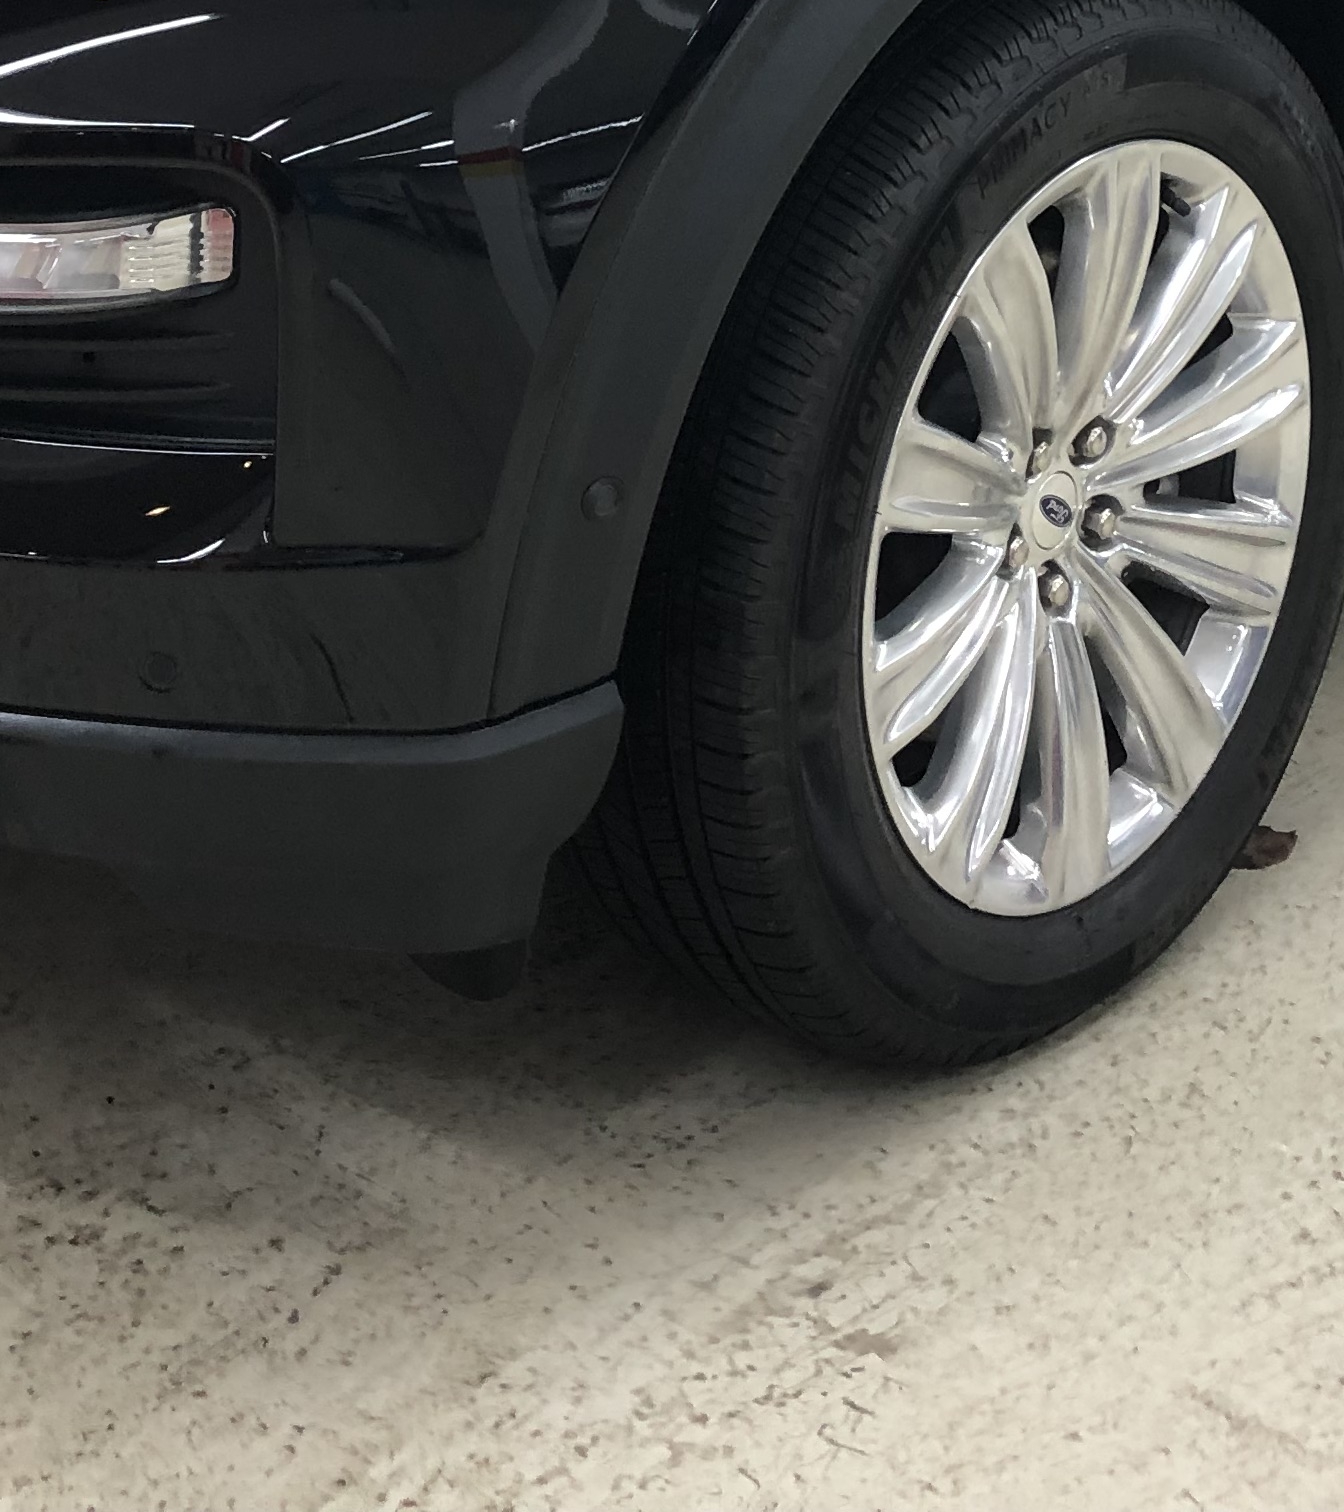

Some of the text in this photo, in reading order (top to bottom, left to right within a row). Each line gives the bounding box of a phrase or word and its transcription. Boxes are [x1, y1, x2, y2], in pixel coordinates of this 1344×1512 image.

[975, 91, 1073, 200] PRIMACY
[833, 222, 960, 534] MICHELIN
[1045, 499, 1070, 524] Ford
